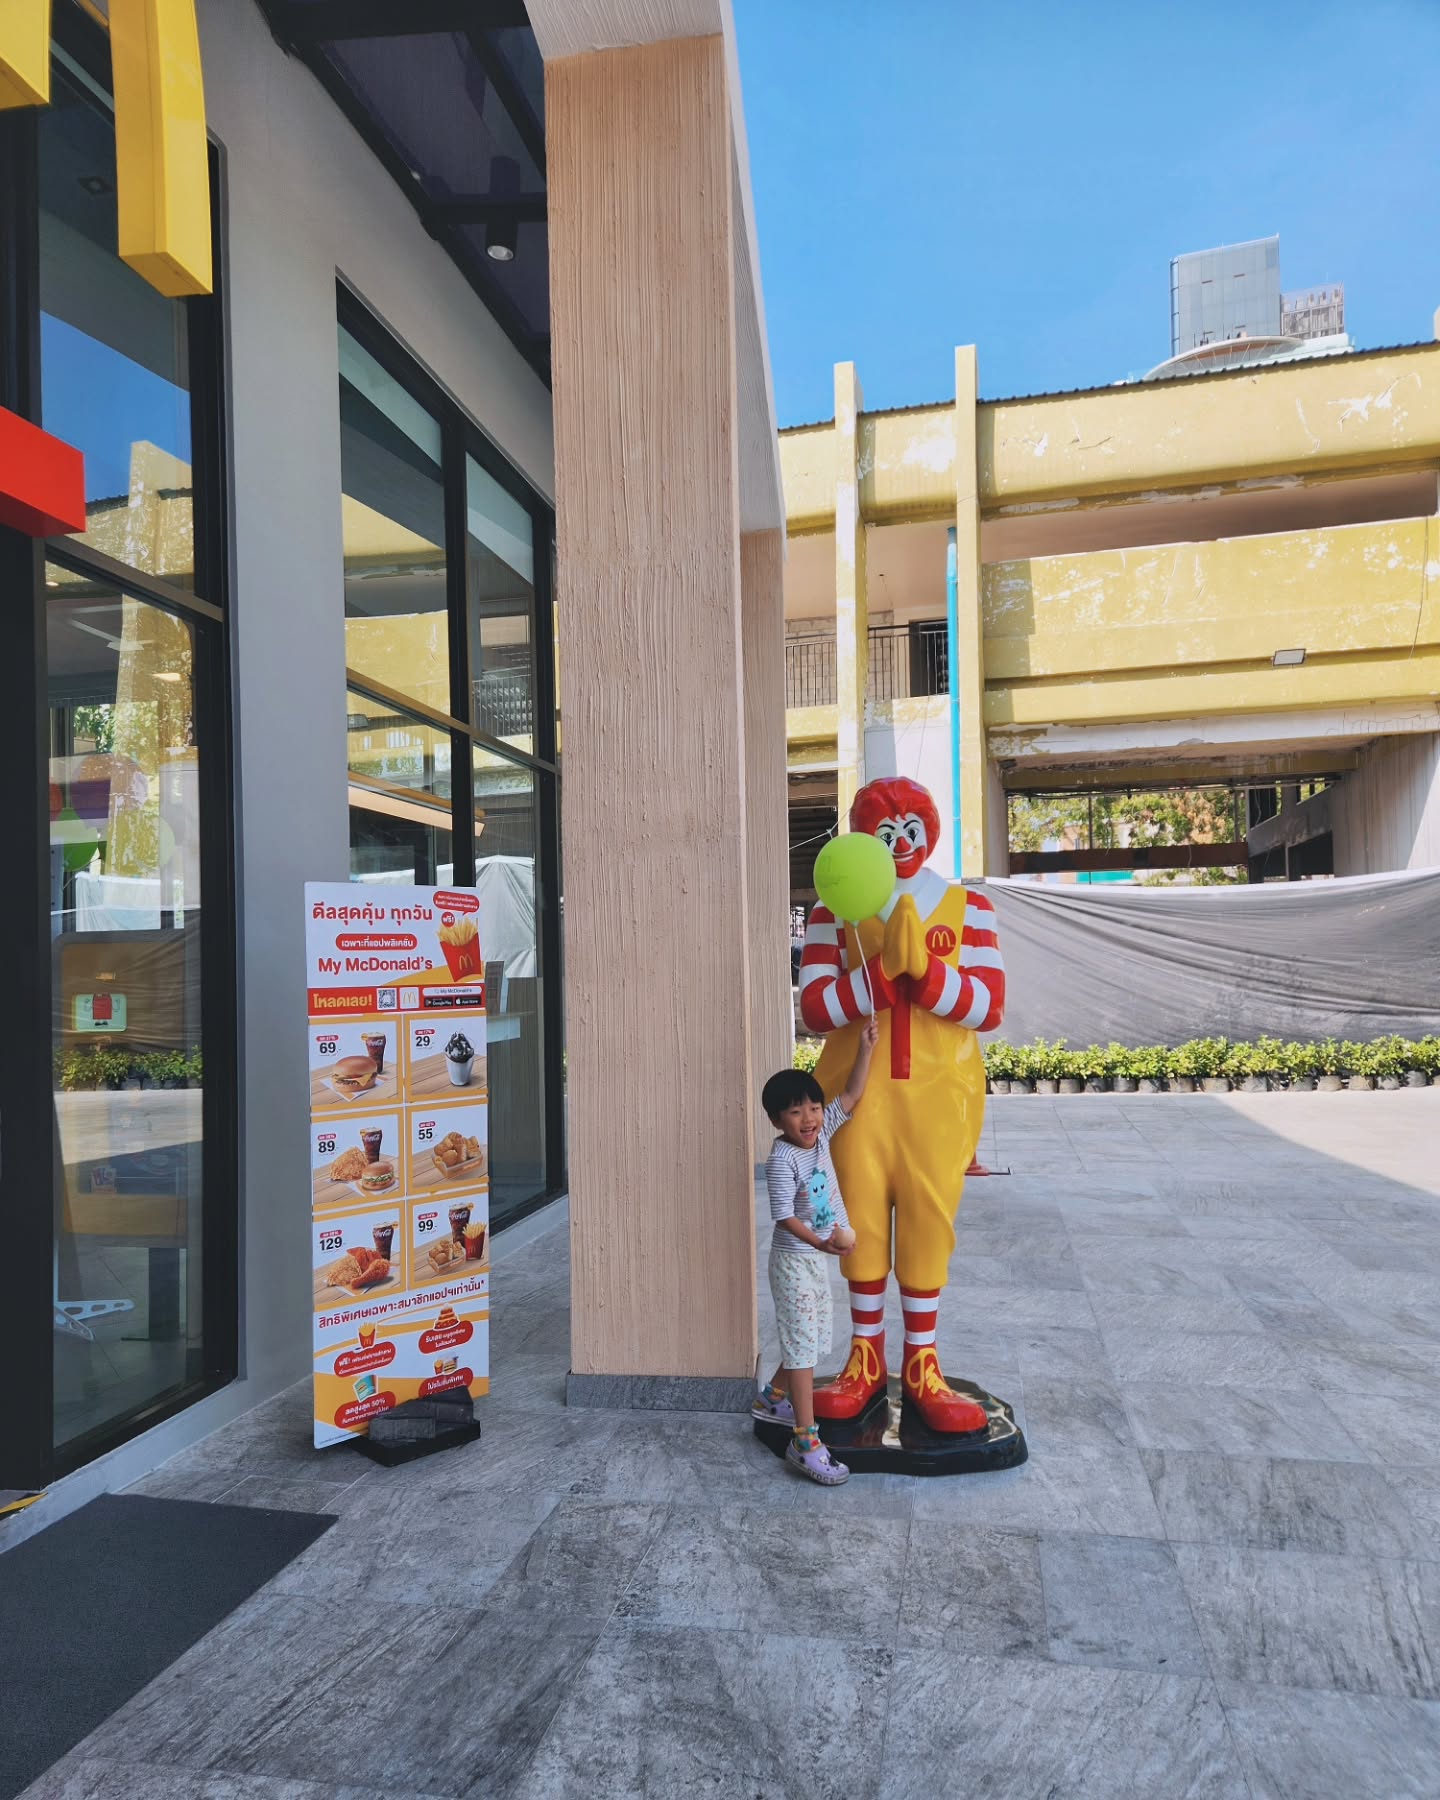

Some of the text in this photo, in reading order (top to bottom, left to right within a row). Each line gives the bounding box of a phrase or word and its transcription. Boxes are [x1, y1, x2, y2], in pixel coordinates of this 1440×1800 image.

[312, 902, 433, 926] ดีลสุดคุ้ม ทุกวัน
[318, 956, 433, 976] My McDonald's
[313, 993, 373, 1009] โหลดเลย!
